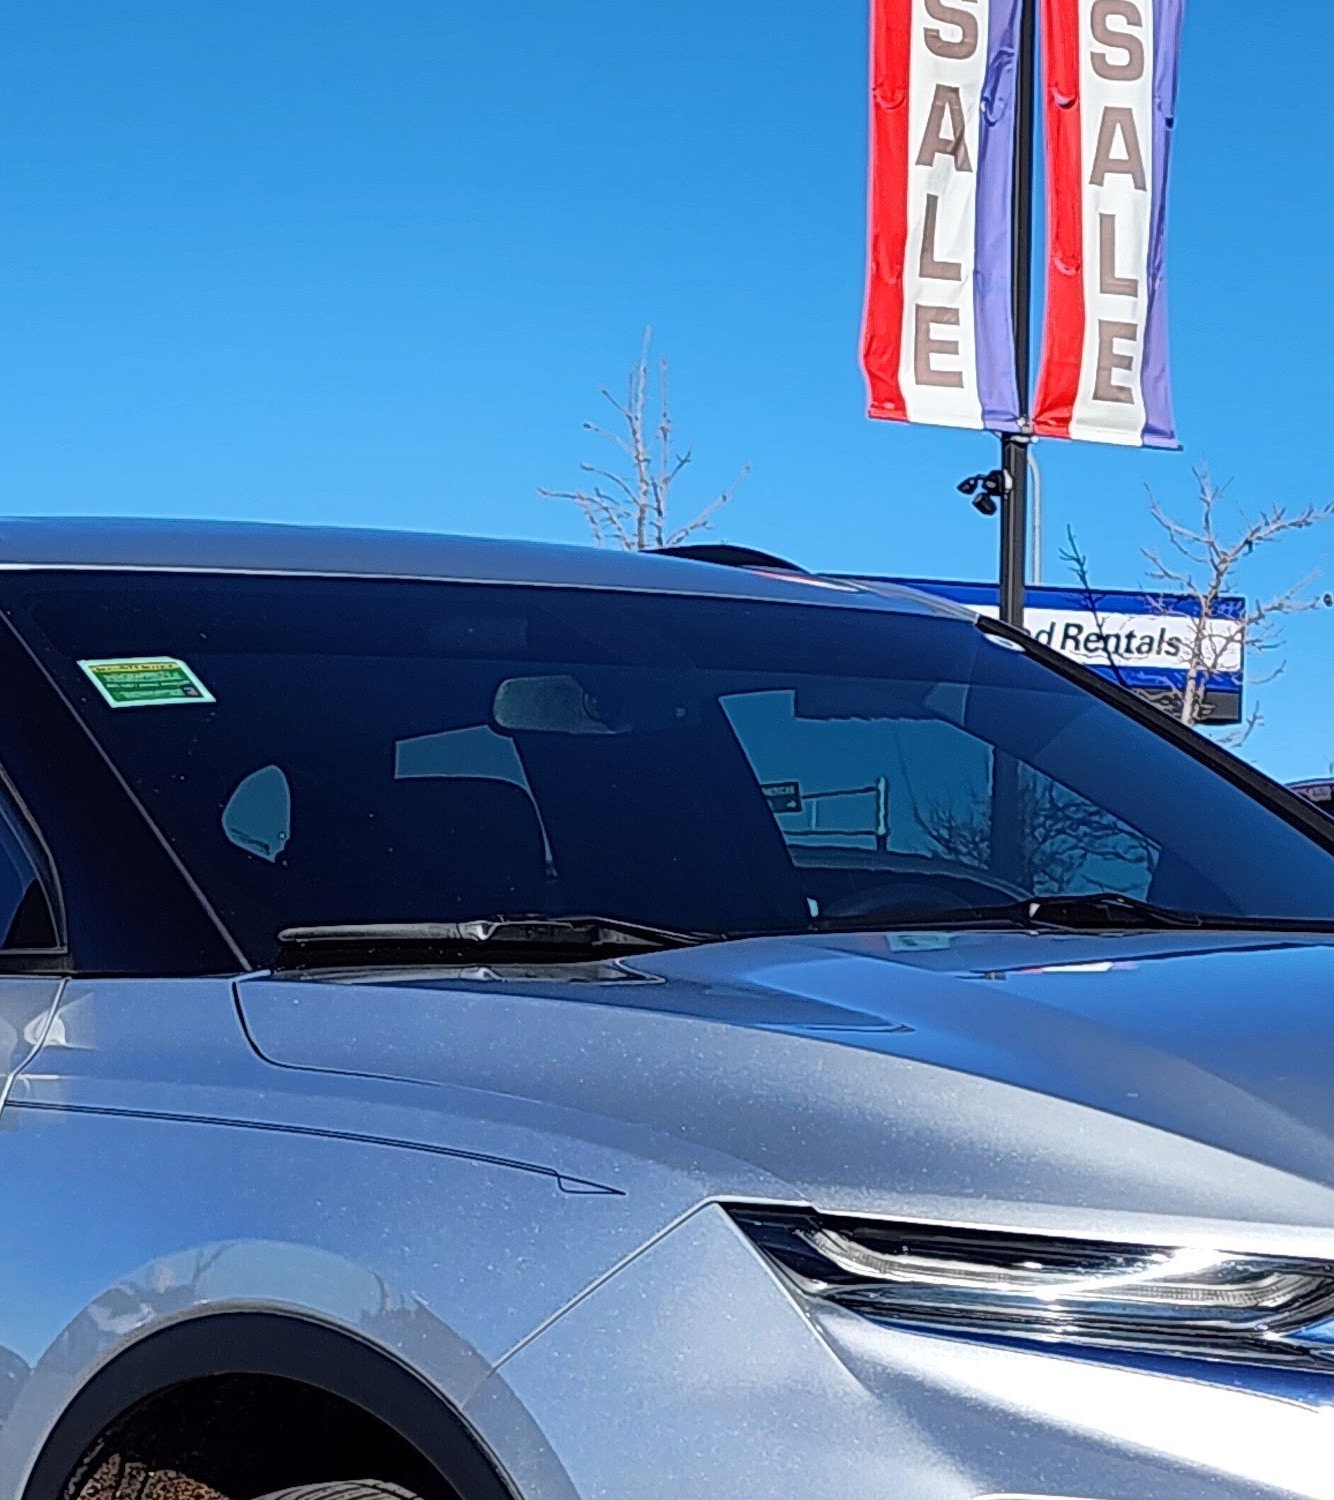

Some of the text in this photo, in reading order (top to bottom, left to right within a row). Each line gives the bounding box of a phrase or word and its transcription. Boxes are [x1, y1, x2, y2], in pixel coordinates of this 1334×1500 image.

[914, 0, 979, 389] SALE
[1088, 0, 1147, 405] SALE
[1060, 622, 1183, 658] Rentals
